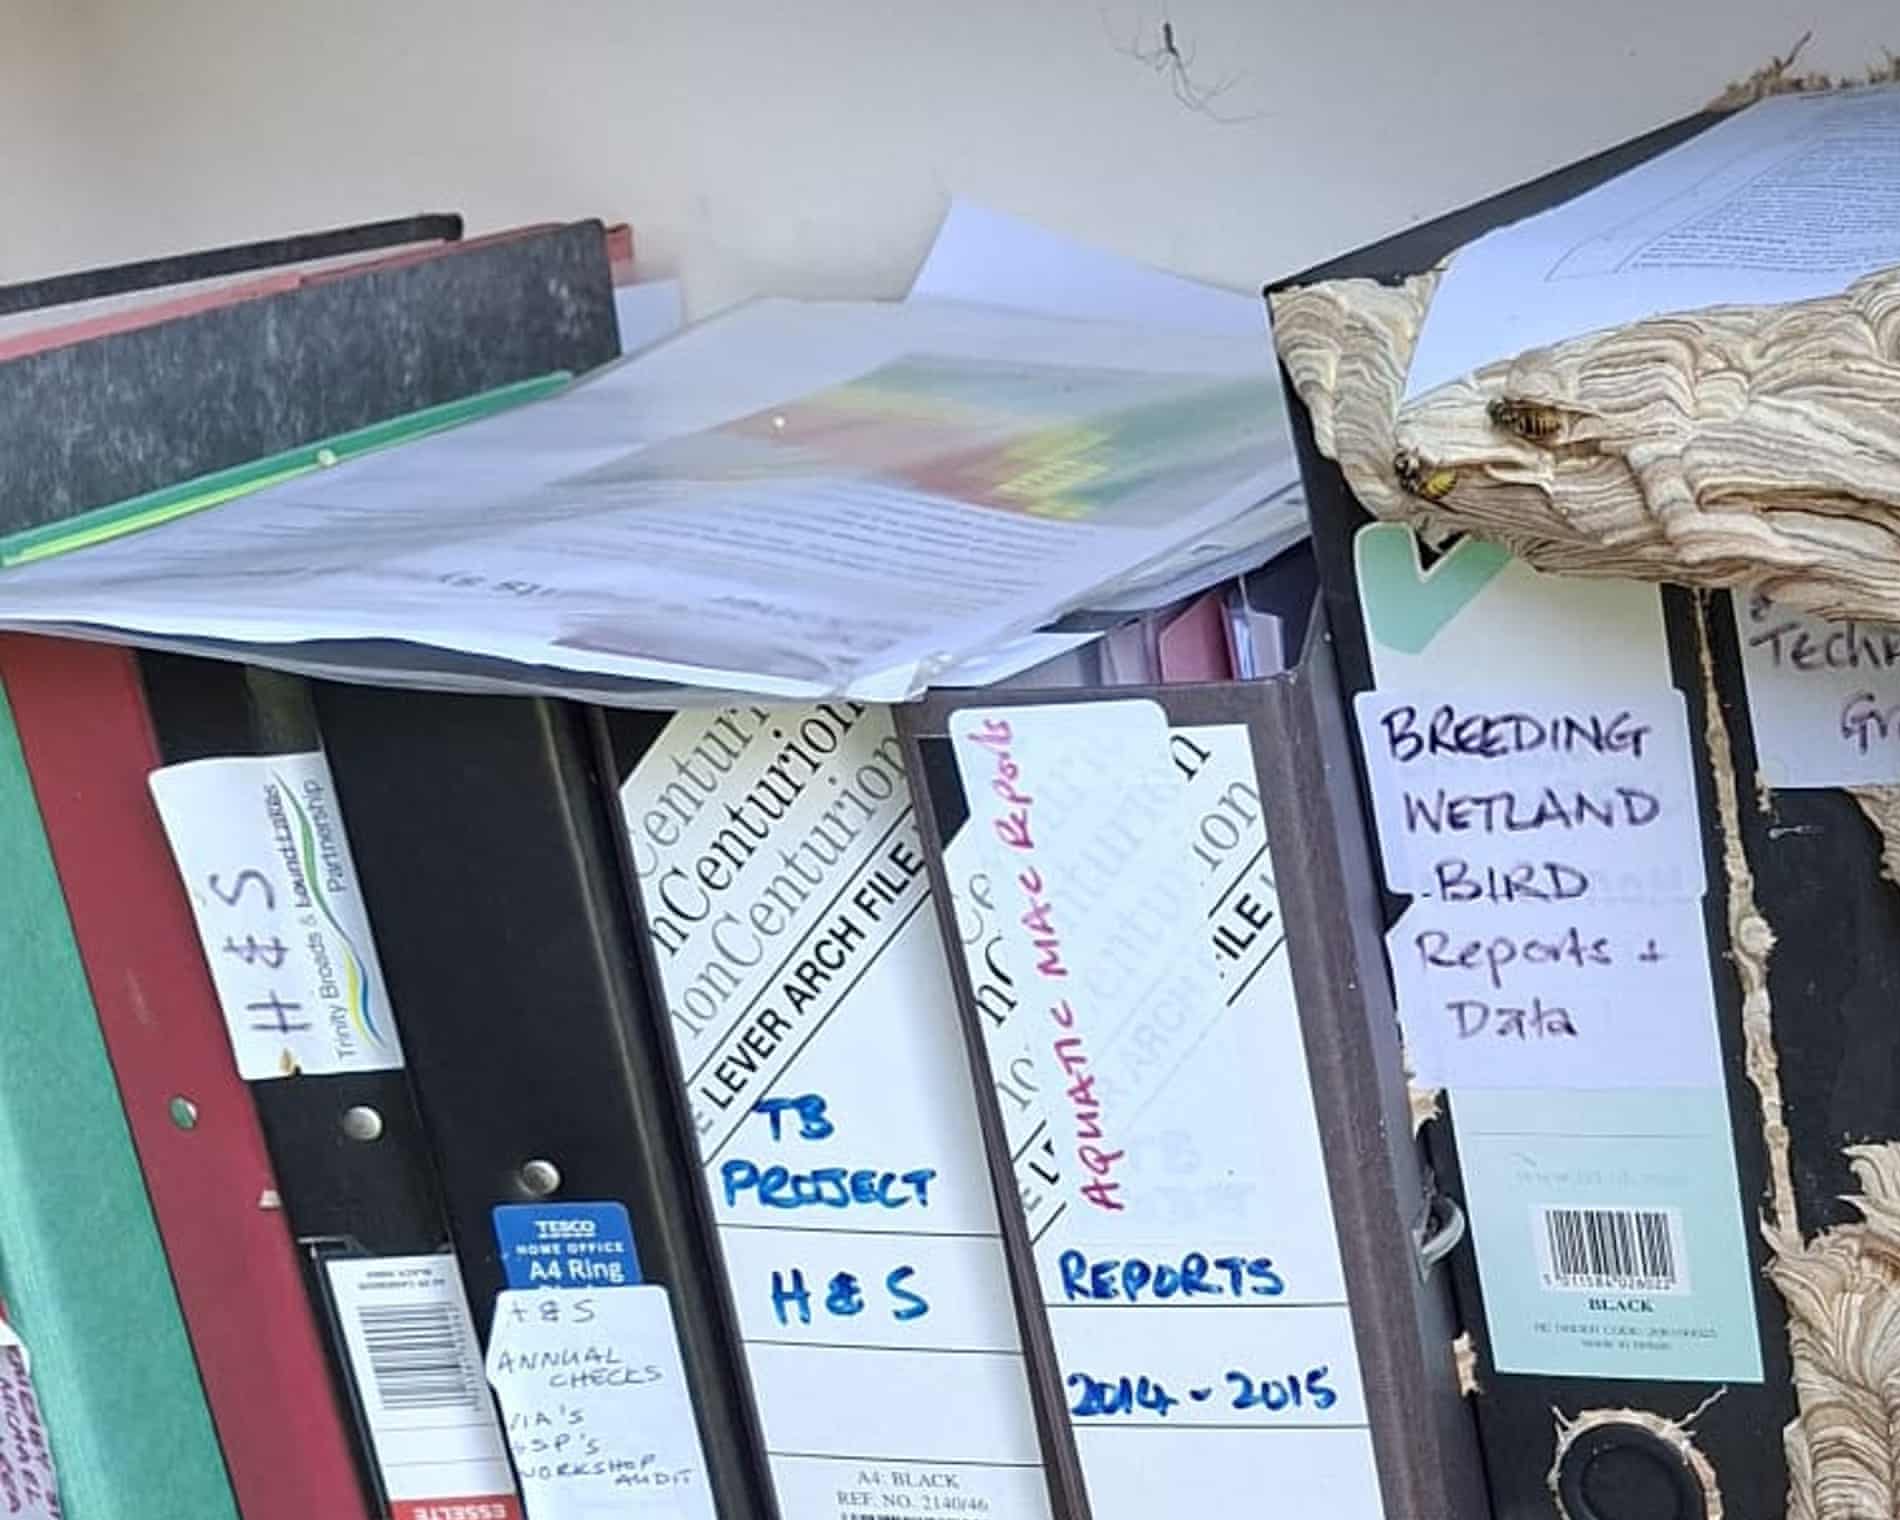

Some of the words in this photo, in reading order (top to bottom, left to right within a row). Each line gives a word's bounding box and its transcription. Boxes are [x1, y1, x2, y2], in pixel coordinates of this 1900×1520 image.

[1379, 707, 1652, 762] BREEDING
[1404, 789, 1663, 834] WETLAND
[305, 780, 347, 893] Partnership
[208, 868, 275, 911] S
[1435, 862, 1588, 904] BIRD
[1211, 892, 1274, 965] ILE
[306, 931, 341, 999] Broads
[701, 1007, 793, 1110] LEVER
[783, 915, 865, 1015] ARCH
[853, 842, 926, 922] FILE
[1415, 929, 1612, 988] Reports
[1638, 940, 1665, 964] +
[245, 989, 312, 1034] H
[1446, 996, 1579, 1039] Data
[752, 1094, 834, 1141] TB
[1050, 1000, 1124, 1211] AQUATIC
[721, 1159, 936, 1208] PROJECT
[534, 1220, 596, 1237] TESCO
[567, 1242, 623, 1254] OFFICE
[530, 1261, 561, 1280] A4
[568, 1259, 623, 1283] Ring
[1058, 1249, 1286, 1303] REPORTS
[572, 1299, 595, 1322] S
[770, 1268, 812, 1325] H
[825, 1271, 865, 1316] &
[886, 1265, 929, 1320] S
[1588, 1298, 1654, 1312] BLACK
[498, 1348, 622, 1374] ANNUAL
[550, 1365, 662, 1388] CHECKS
[1066, 1372, 1179, 1417] 2014
[1225, 1366, 1338, 1411] 2015
[892, 1471, 960, 1489] BLACK
